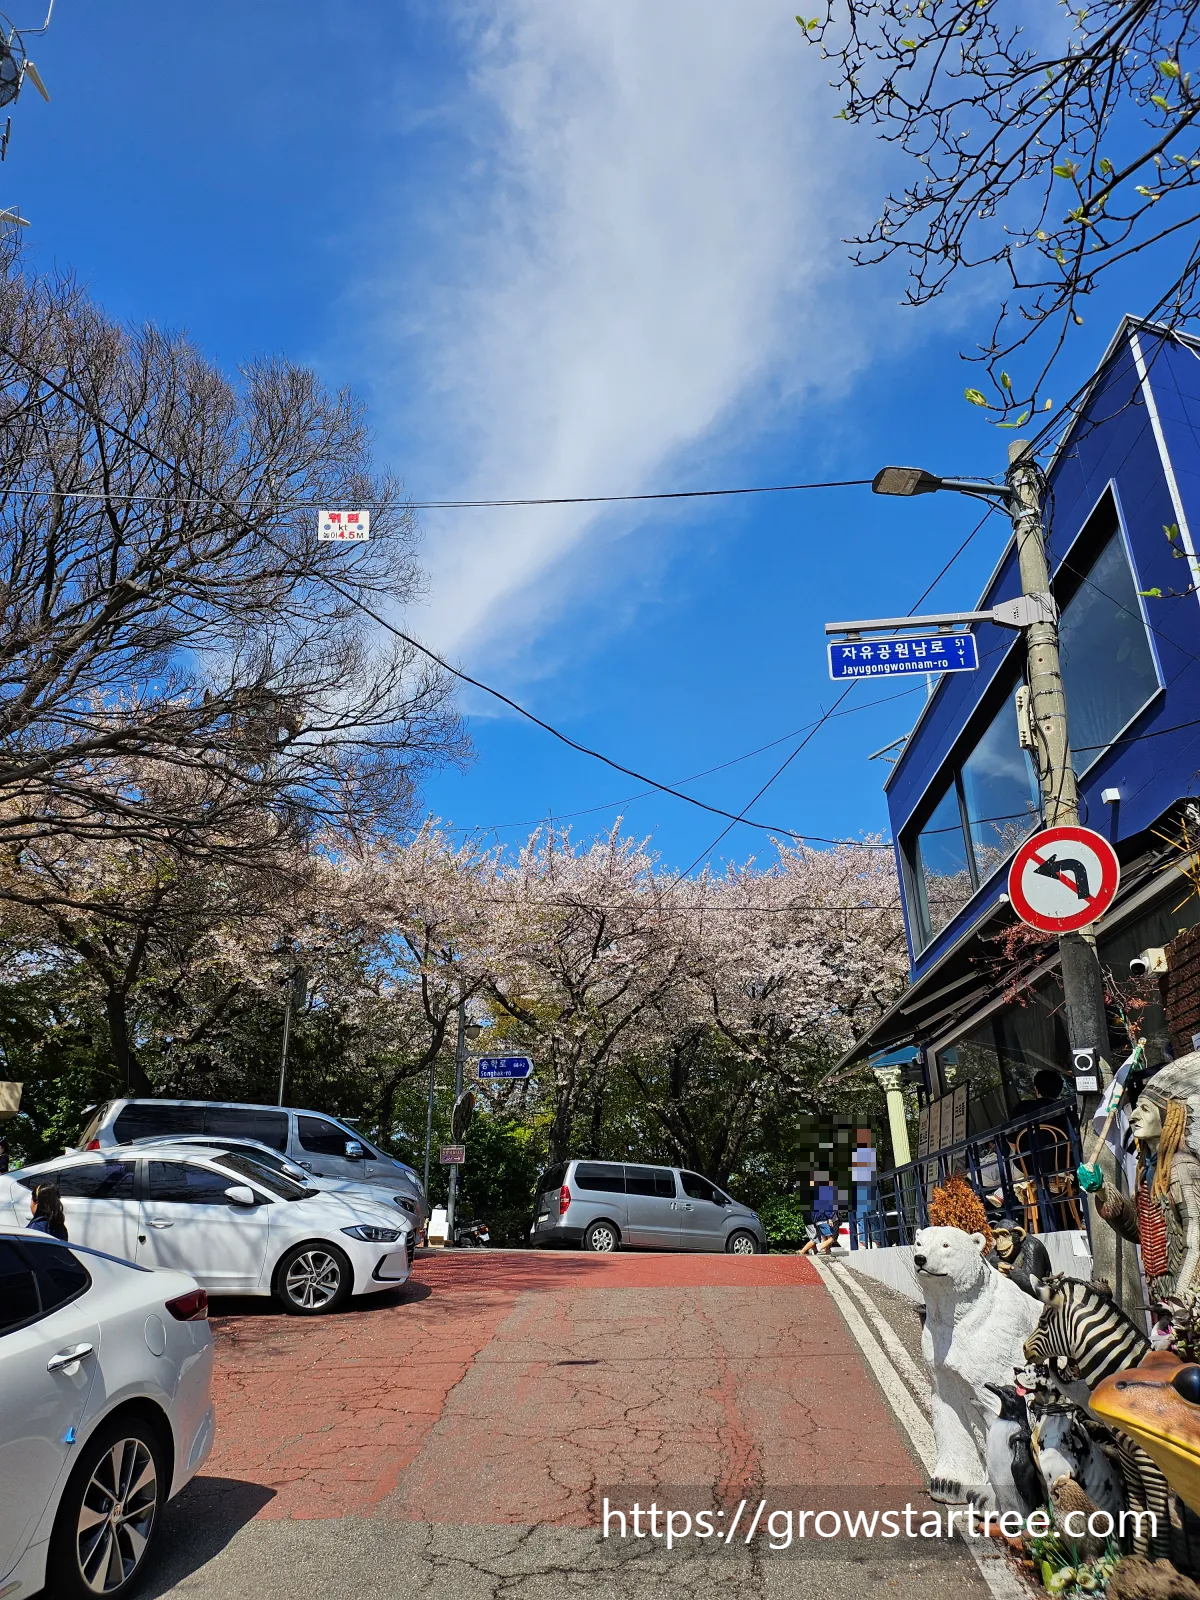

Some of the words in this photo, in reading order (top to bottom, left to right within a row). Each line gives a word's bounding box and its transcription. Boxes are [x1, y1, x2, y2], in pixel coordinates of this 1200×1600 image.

[955, 638, 965, 647] 51
[841, 640, 945, 660] 자유공원남로
[841, 658, 949, 676] Jayugongwonnam-ro
[960, 658, 965, 666] 1
[481, 1060, 507, 1070] 송학로
